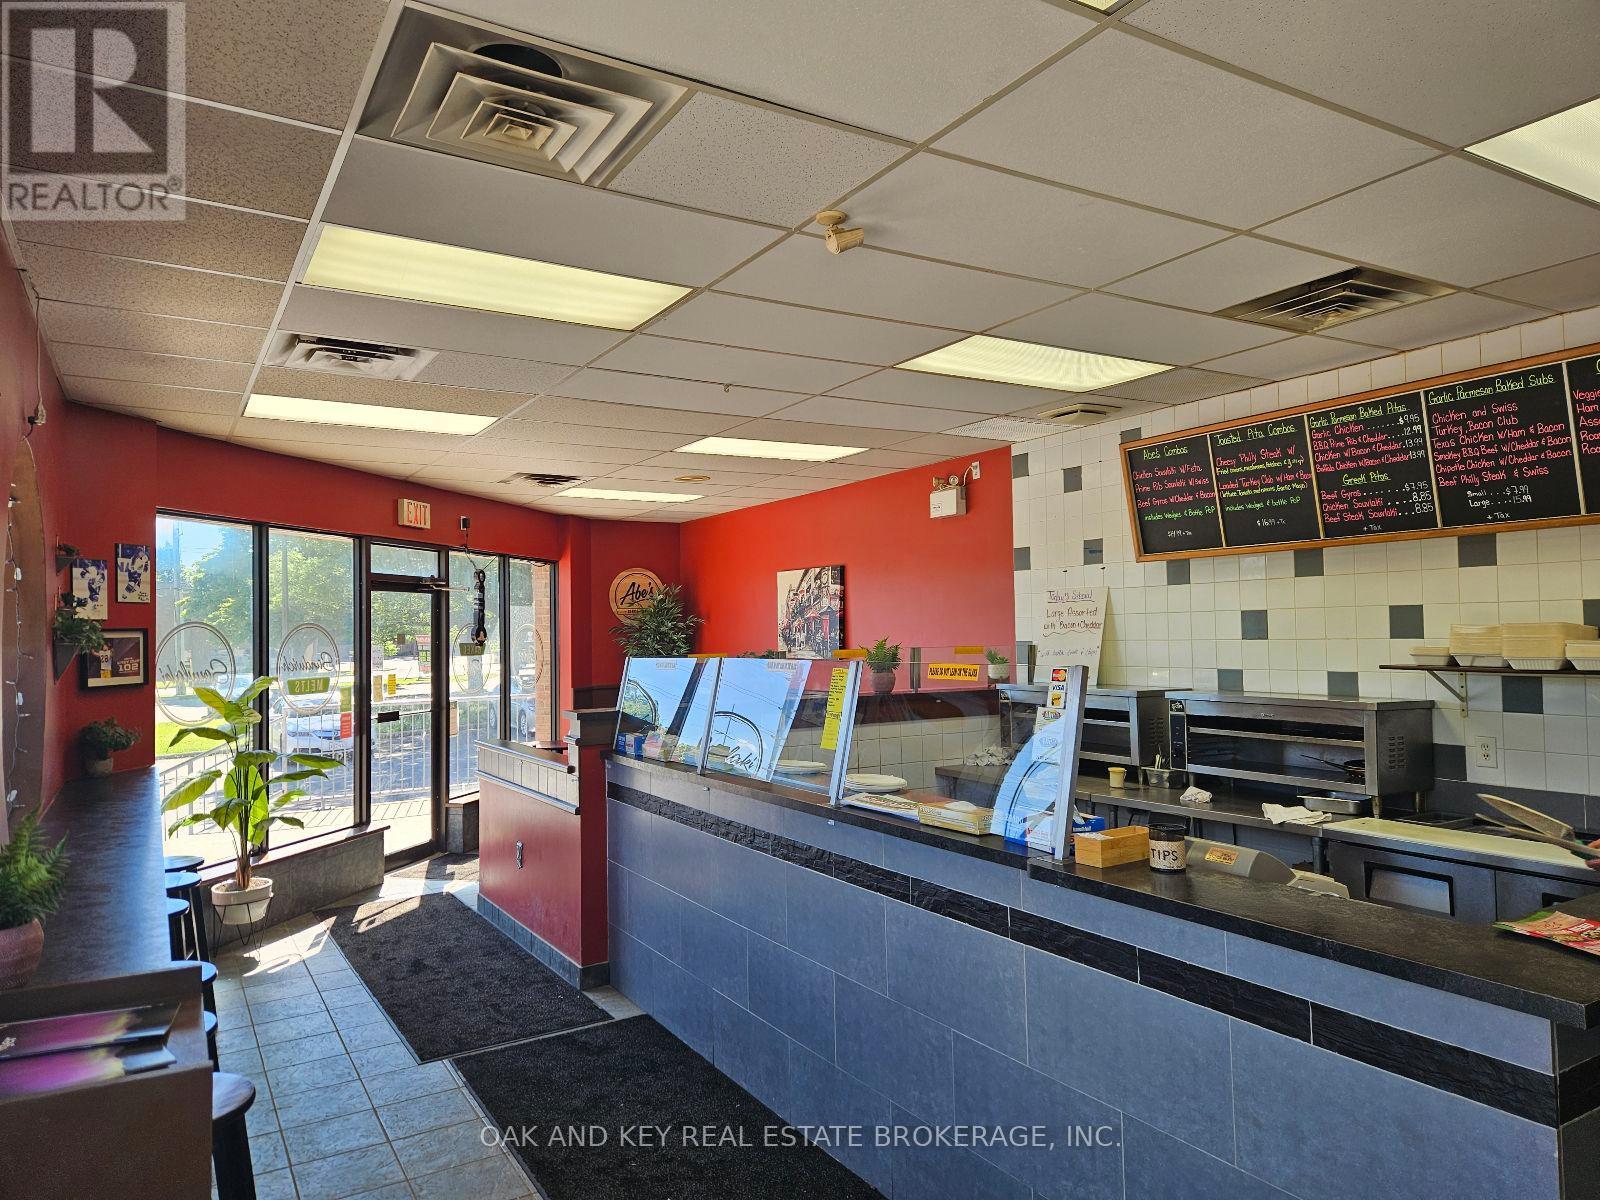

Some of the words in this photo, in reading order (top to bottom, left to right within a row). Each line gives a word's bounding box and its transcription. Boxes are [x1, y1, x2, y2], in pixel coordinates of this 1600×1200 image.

[1429, 392, 1454, 405] Garlic
[1455, 385, 1494, 399] Parmesan
[1495, 377, 1525, 392] Baked
[1529, 373, 1555, 387] Subs
[1310, 416, 1328, 428] Garlic
[1358, 405, 1383, 419] Baked
[1387, 402, 1408, 414] Pitas
[1432, 410, 1467, 424] Chicken
[1472, 406, 1487, 416] and
[1492, 402, 1518, 413] Swiss
[1577, 403, 1599, 413] Ham
[1312, 430, 1331, 438] Garlic
[1334, 423, 1364, 435] Chicken
[1468, 419, 1493, 432] Bacon
[1497, 415, 1518, 425] Club
[1214, 431, 1242, 446] Toasted
[1248, 428, 1265, 440] Pita
[1268, 423, 1296, 436] Combos
[1363, 433, 1387, 443] Cheddar
[1431, 438, 1455, 449] Texas
[1460, 432, 1494, 445] Chicken
[1529, 424, 1535, 434] &
[1537, 422, 1564, 434] Bacon
[1164, 445, 1188, 457] Combos
[1261, 448, 1282, 459] Steak
[1314, 450, 1340, 462] Chicken
[1377, 442, 1402, 452] Cheddar
[1434, 451, 1461, 463] Smokey
[1480, 444, 1499, 455] Beef
[1547, 436, 1572, 446] Bacon
[1436, 463, 1465, 474] Chipotle
[1466, 459, 1495, 470] Chicken
[1547, 449, 1572, 459] Bacon
[1342, 474, 1367, 486] Greek
[1370, 470, 1391, 482] Pitas
[1438, 476, 1457, 487] Beef
[1460, 475, 1479, 486] Philly
[1482, 470, 1506, 481] Steak
[1514, 469, 1519, 478] &
[1523, 465, 1549, 477] Swiss
[1321, 490, 1338, 499] Beef
[1341, 489, 1361, 500] Gyros
[1322, 501, 1349, 512] Chicken
[1413, 491, 1432, 502] 8.85
[1468, 499, 1490, 508] Large
[407, 501, 428, 527] EXIT
[1343, 511, 1364, 521] Steak
[1368, 508, 1398, 519] Souvlaki
[1415, 503, 1434, 514] 8.85
[1494, 511, 1511, 519] Tax
[620, 582, 654, 605] Abe's
[1047, 609, 1063, 621] Large
[1067, 607, 1098, 617] Assorted
[1150, 848, 1178, 862] TIPS
